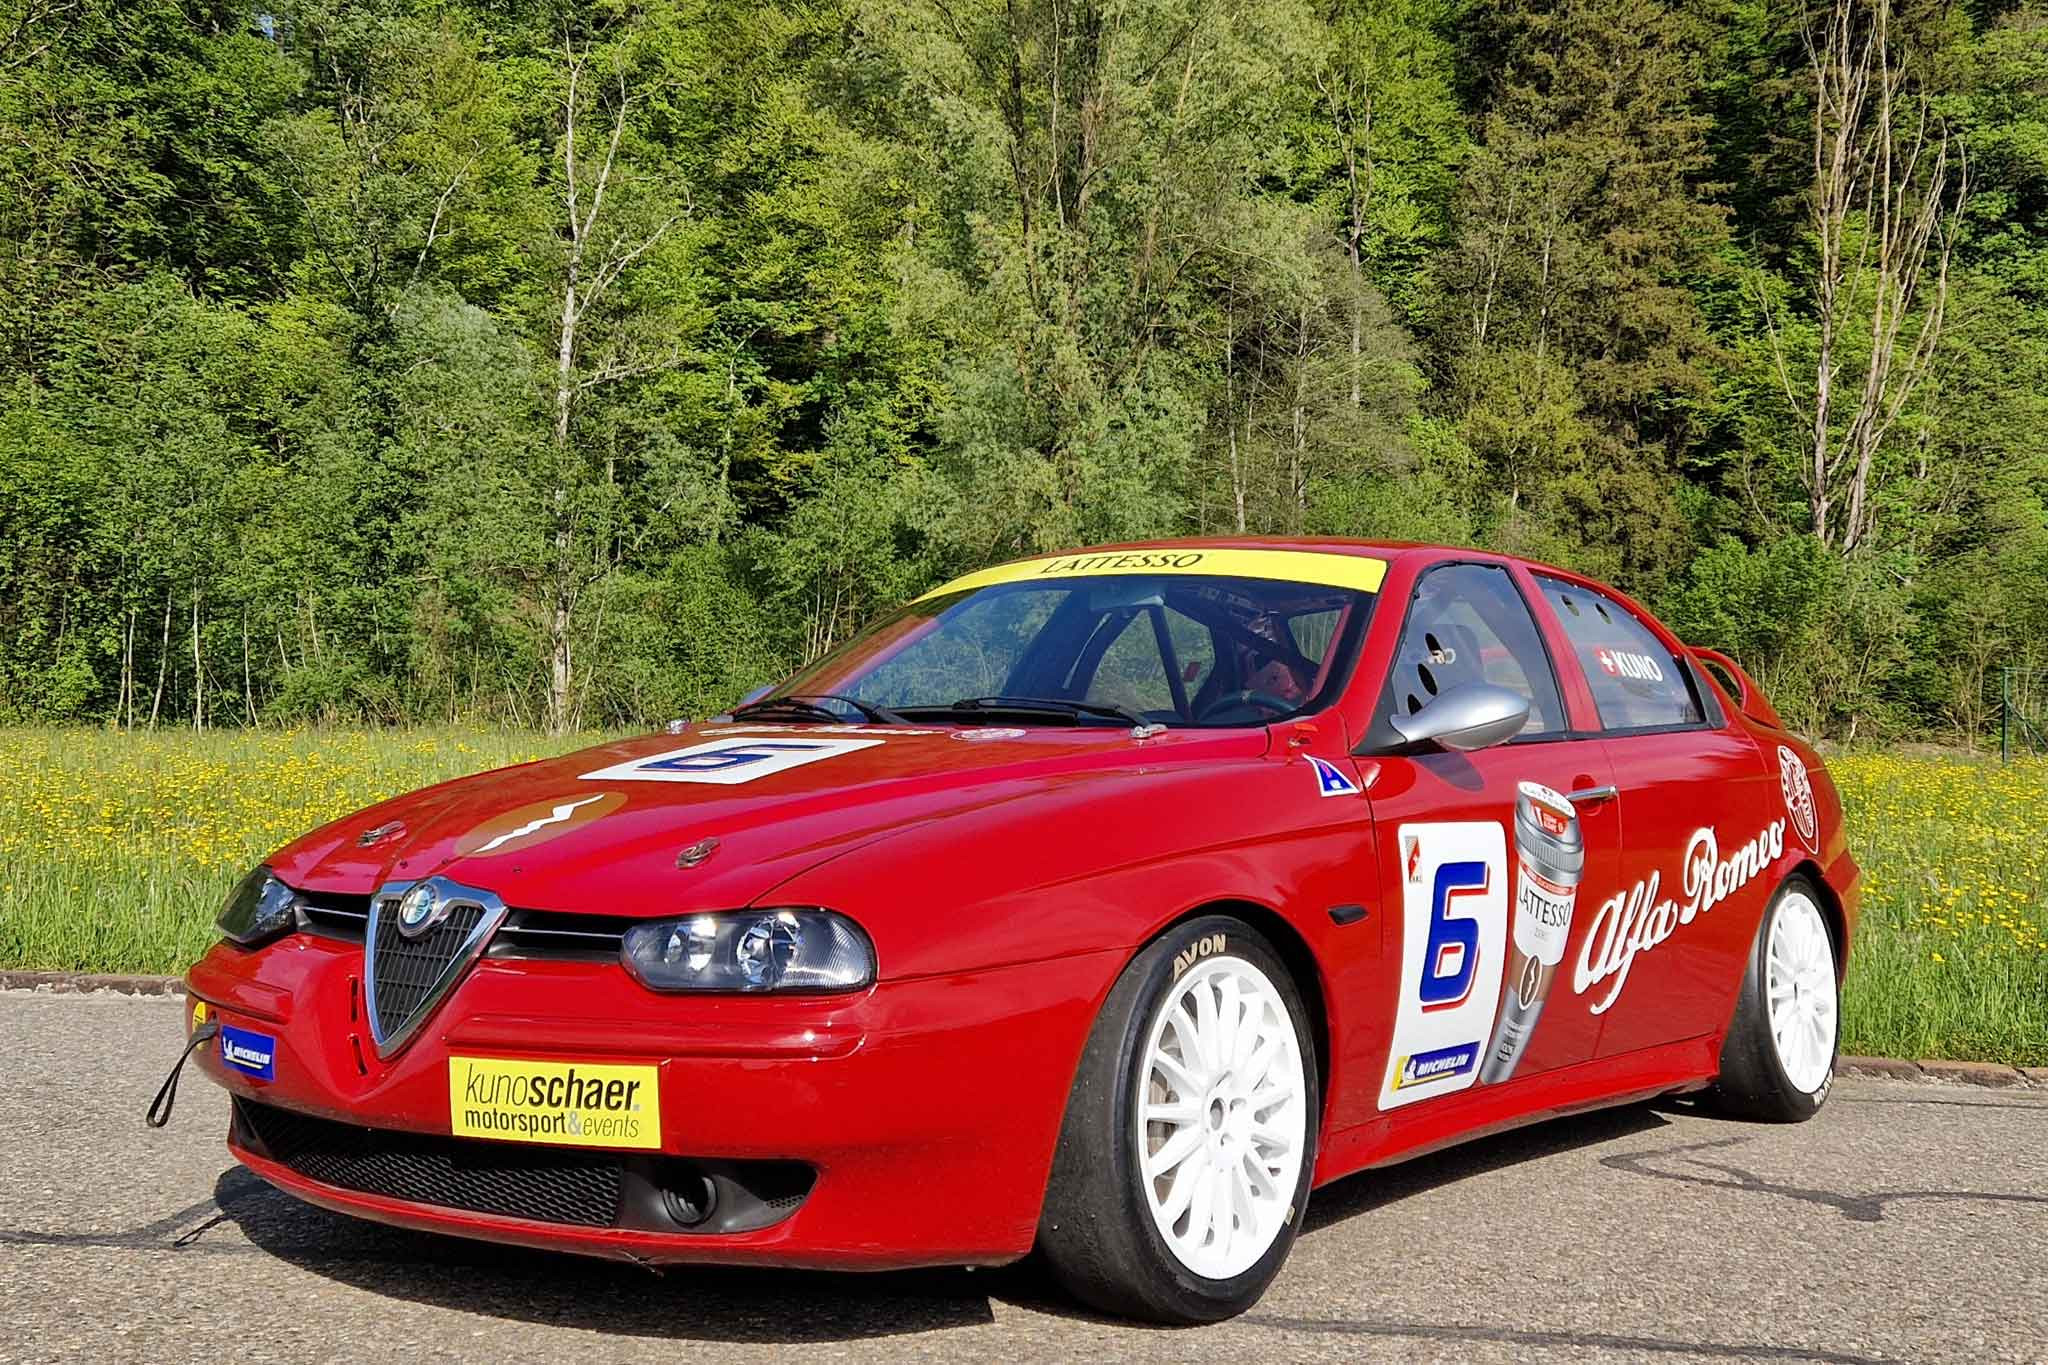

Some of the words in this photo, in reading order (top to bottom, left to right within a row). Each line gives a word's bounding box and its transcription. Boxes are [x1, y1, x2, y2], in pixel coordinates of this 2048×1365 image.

[1040, 553, 1204, 574] LATTESSO
[1610, 649, 1665, 682] KUNO
[635, 743, 834, 772] 6
[1518, 874, 1572, 928] LATTESSO
[1574, 870, 1679, 1015] Alfa
[1679, 816, 1786, 925] Romeo
[1419, 861, 1489, 1010] 6
[1172, 933, 1227, 985] AVON
[232, 1045, 272, 1065] MICHELIN
[1416, 1053, 1471, 1077] MICHELIN
